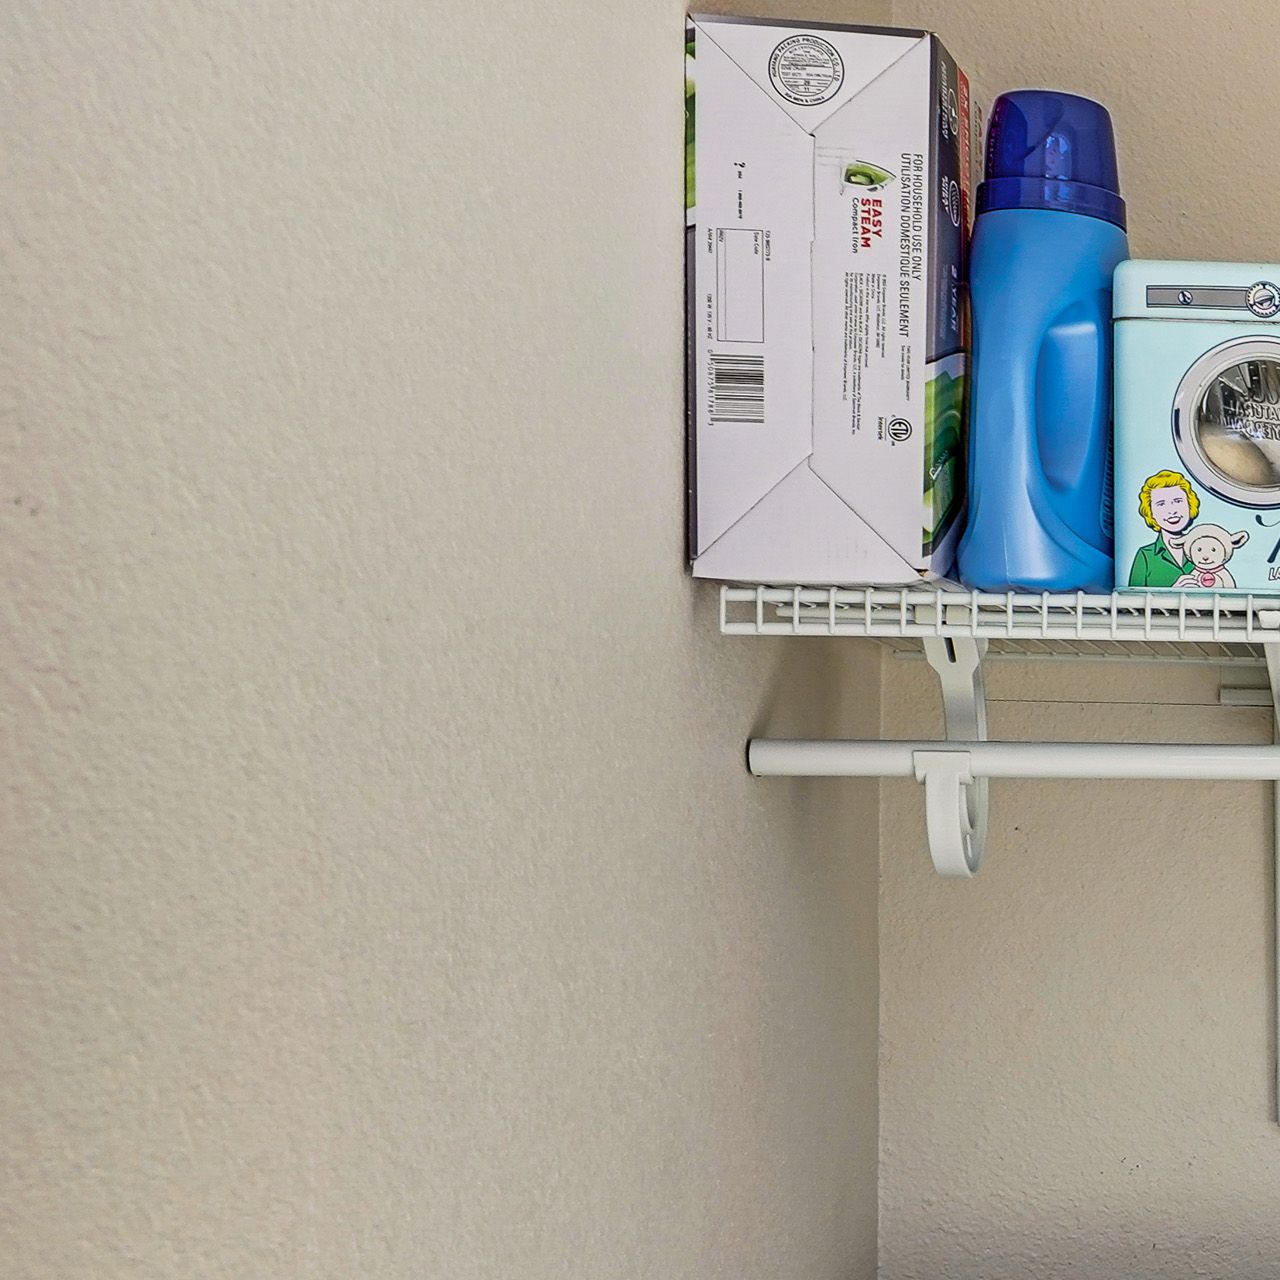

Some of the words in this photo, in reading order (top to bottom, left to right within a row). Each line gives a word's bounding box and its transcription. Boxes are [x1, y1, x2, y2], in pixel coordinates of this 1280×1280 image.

[900, 153, 911, 212] UTILISATION
[912, 153, 923, 172] FOR
[851, 197, 859, 234] Compact
[861, 198, 871, 248] STEAM
[872, 199, 882, 239] EASY
[912, 174, 923, 232] HOUSEHOLD
[899, 215, 911, 278] DOMESTIQUE
[911, 234, 922, 253] USE
[911, 256, 921, 281] ONLY
[899, 280, 910, 338] SEULEMENT
